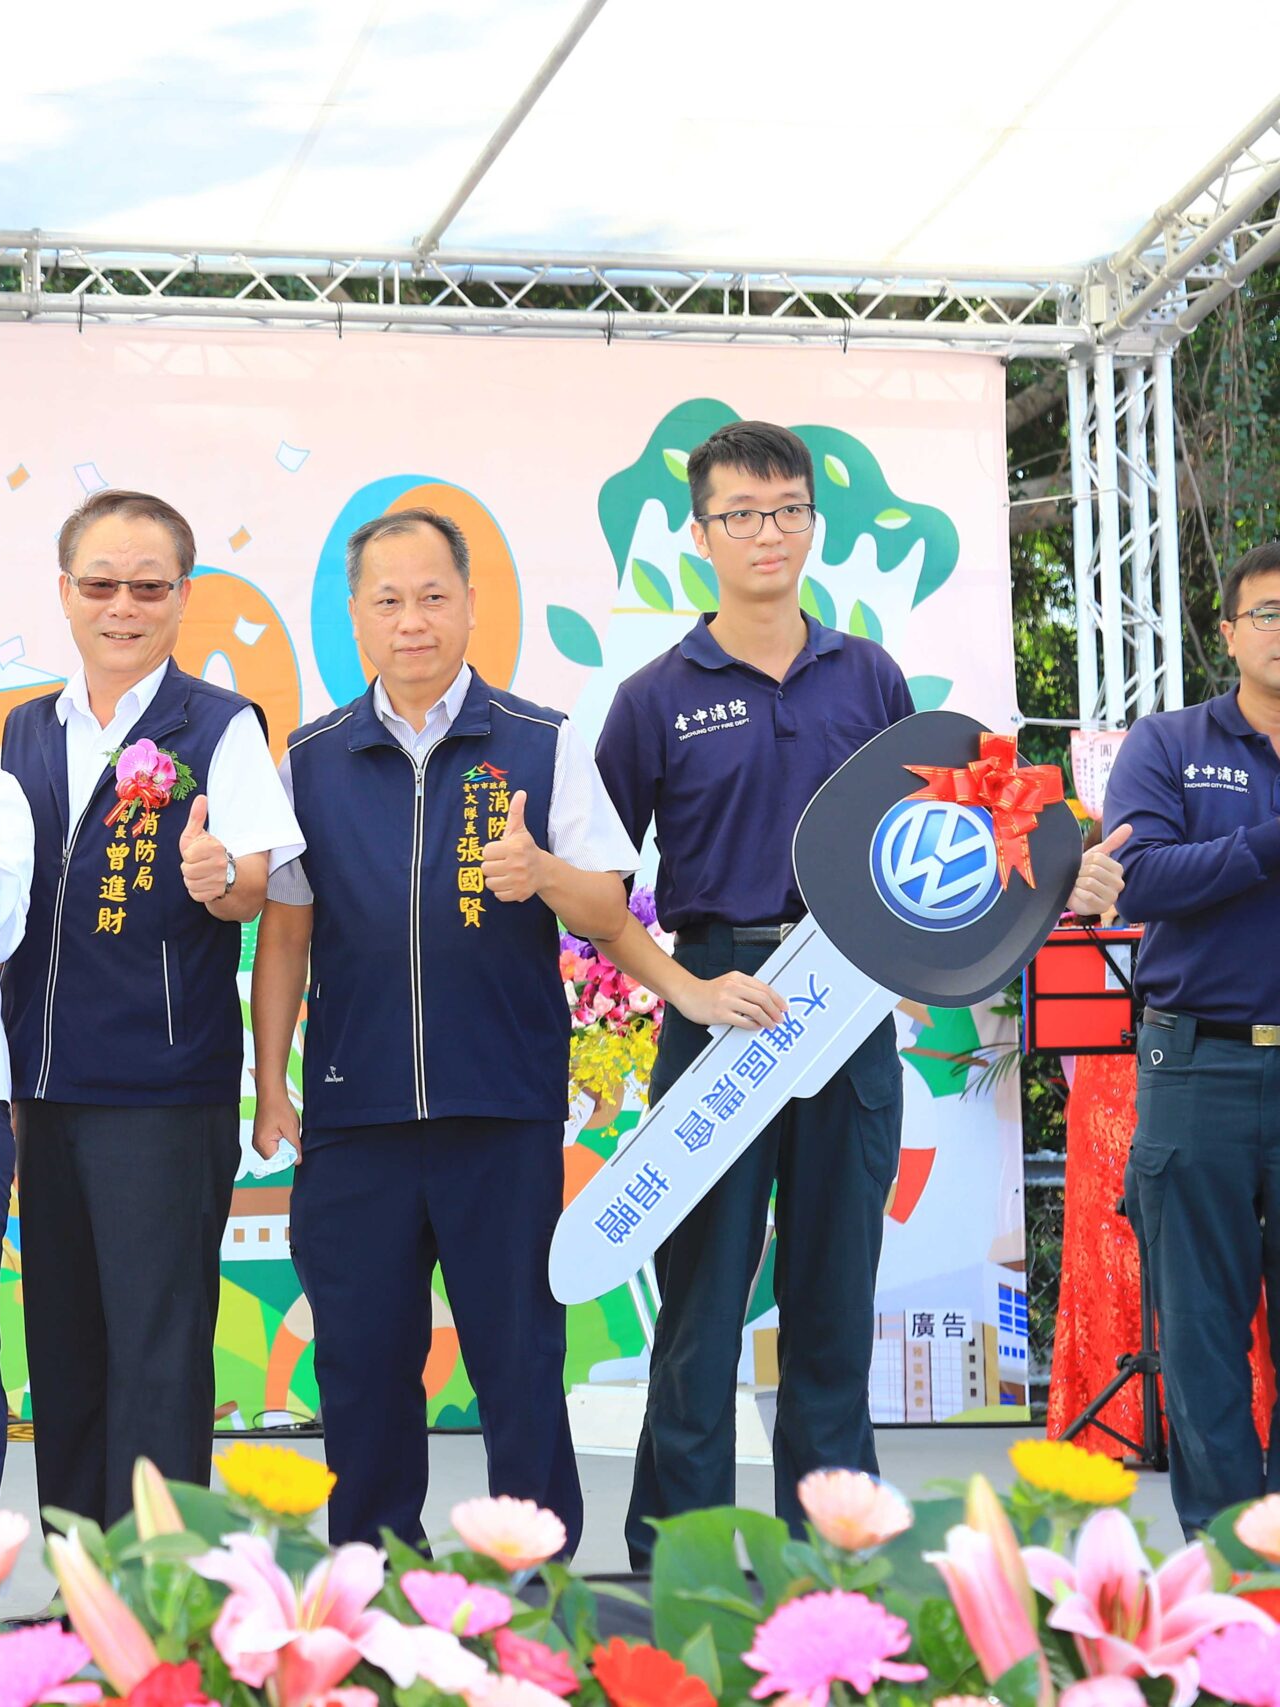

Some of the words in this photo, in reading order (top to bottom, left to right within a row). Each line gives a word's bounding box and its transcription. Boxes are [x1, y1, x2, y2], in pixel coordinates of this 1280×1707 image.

[678, 727, 707, 741] TAICHUNG
[707, 724, 720, 732] CITY
[721, 721, 734, 729] FIRE
[673, 973, 830, 1153] 大雅區農會
[594, 1161, 671, 1245] 捐贈
[911, 1311, 967, 1339] 廣告
